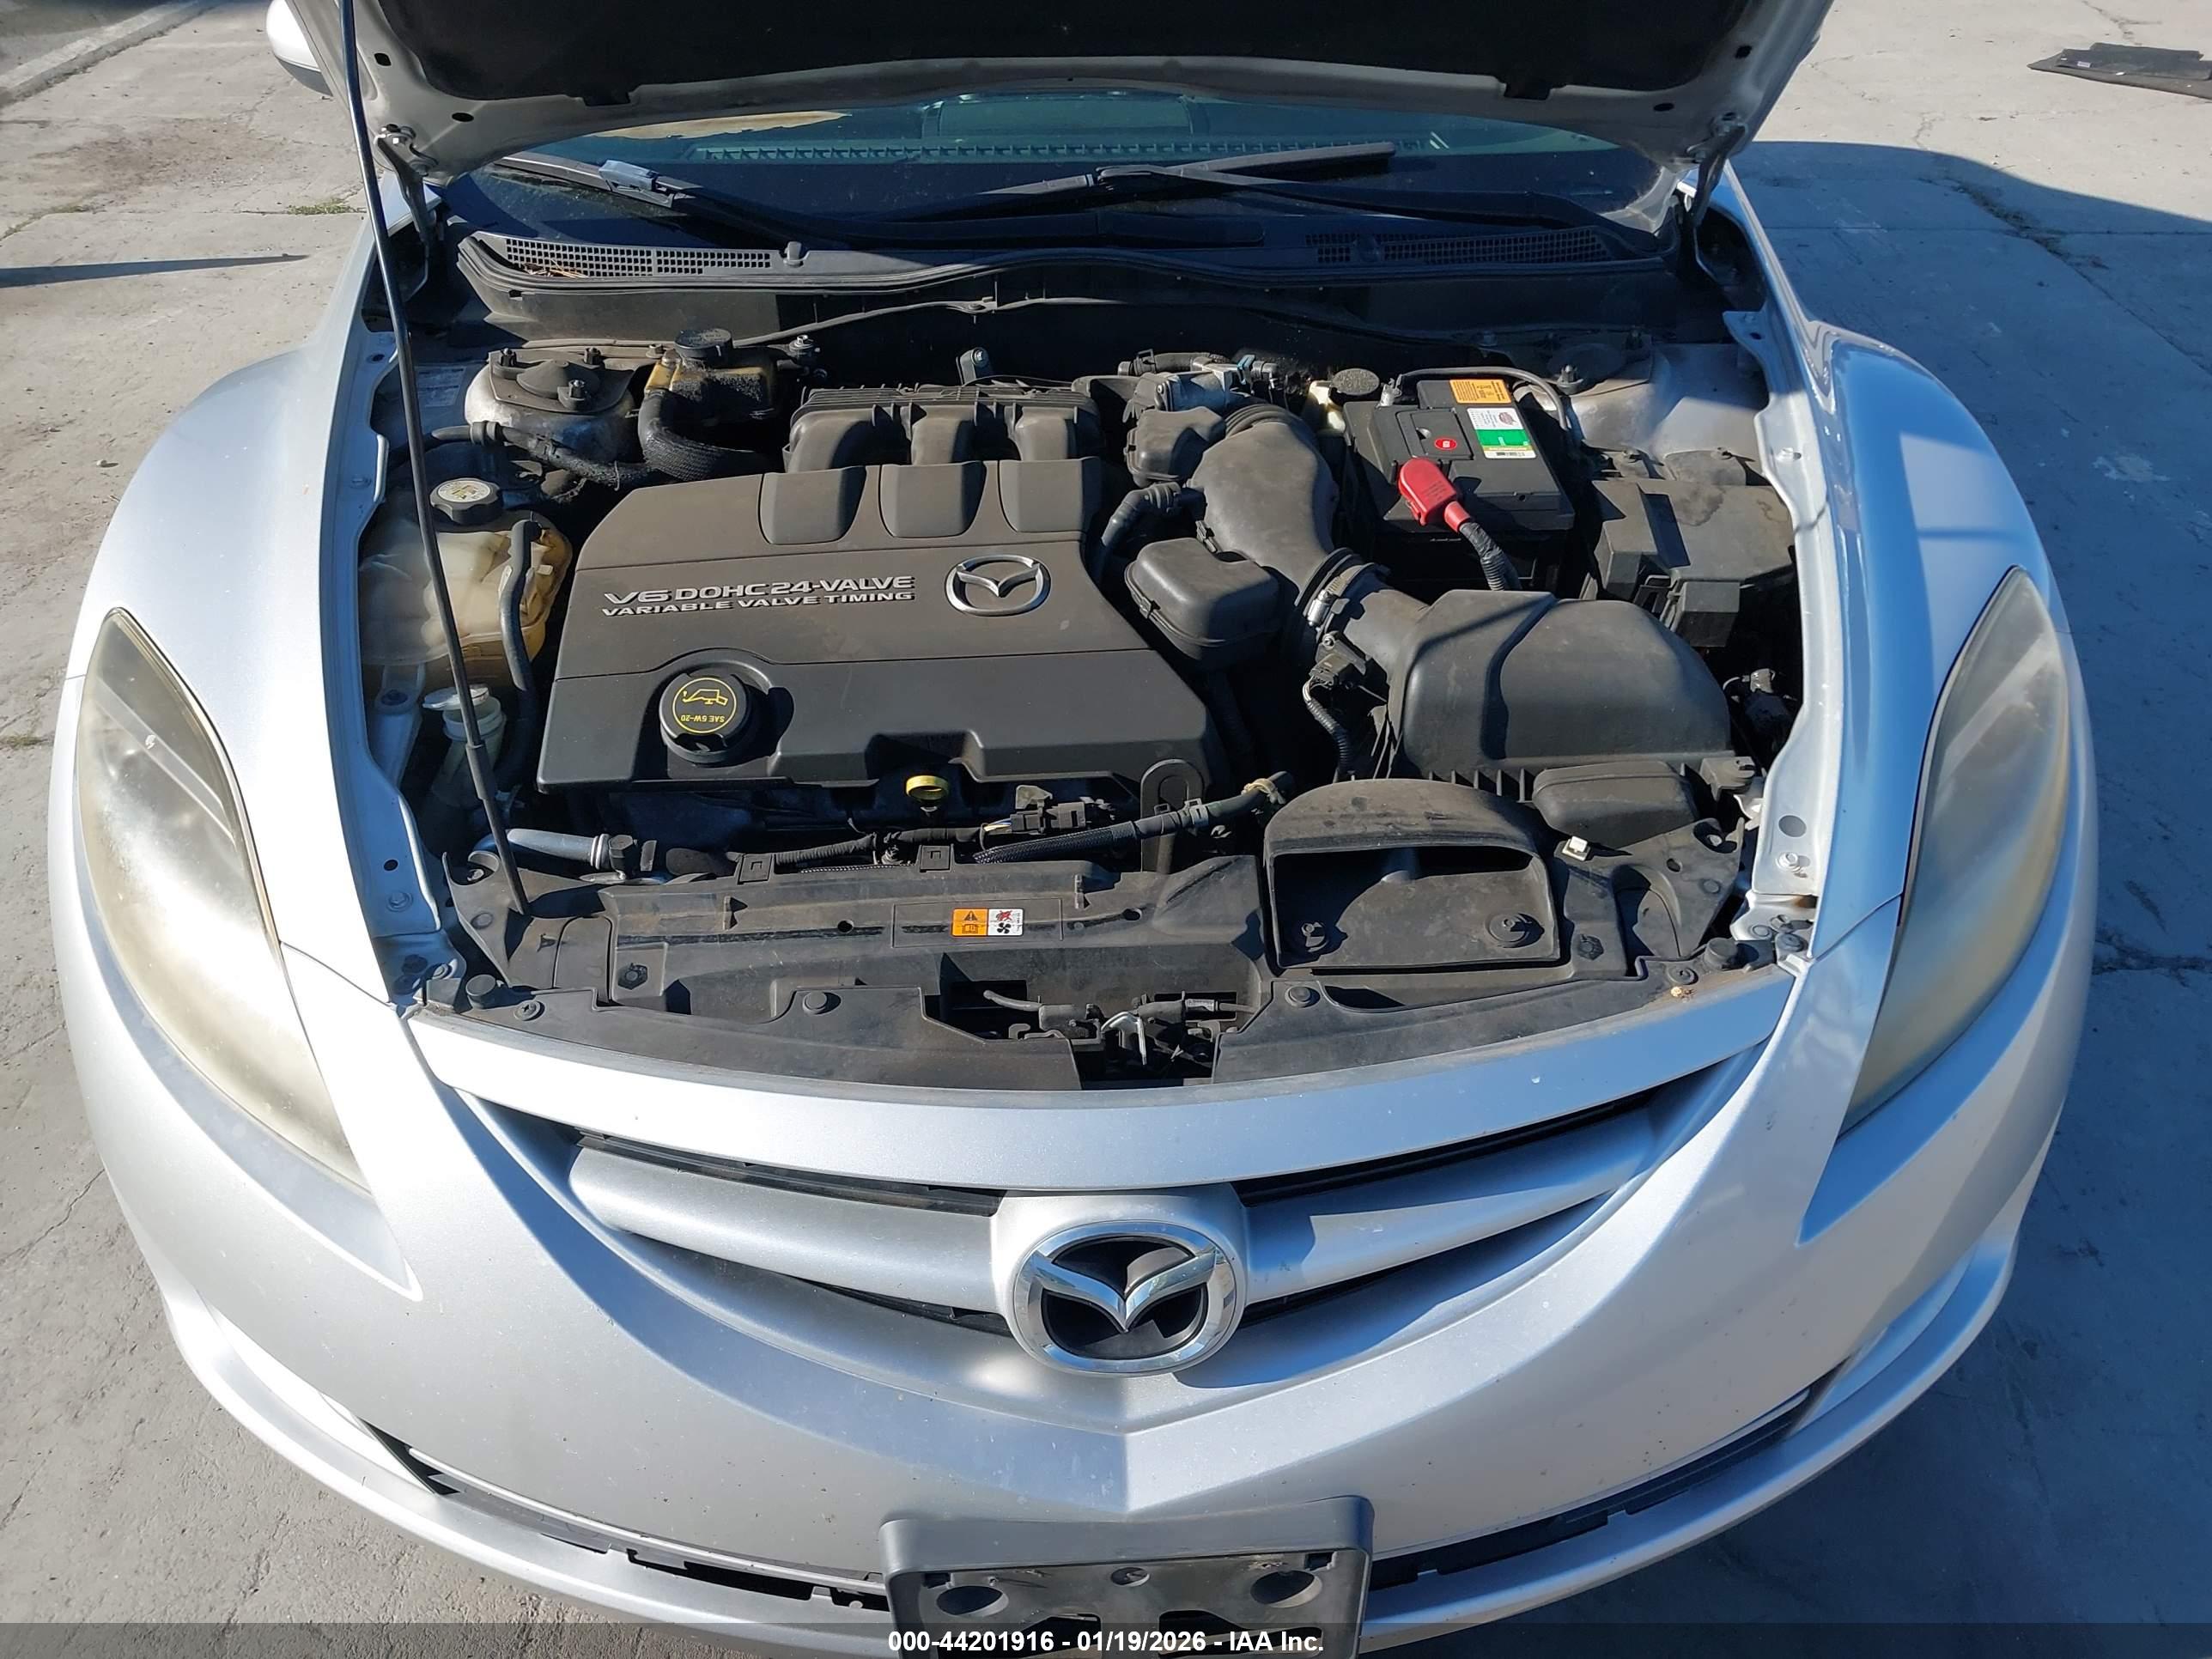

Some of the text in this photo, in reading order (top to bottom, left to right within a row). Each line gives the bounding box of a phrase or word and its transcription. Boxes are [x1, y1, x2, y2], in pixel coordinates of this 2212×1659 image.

[605, 576, 915, 605] V6 DOHC 24-VALVE
[602, 592, 915, 617] VARIABLE VALVE TIMING
